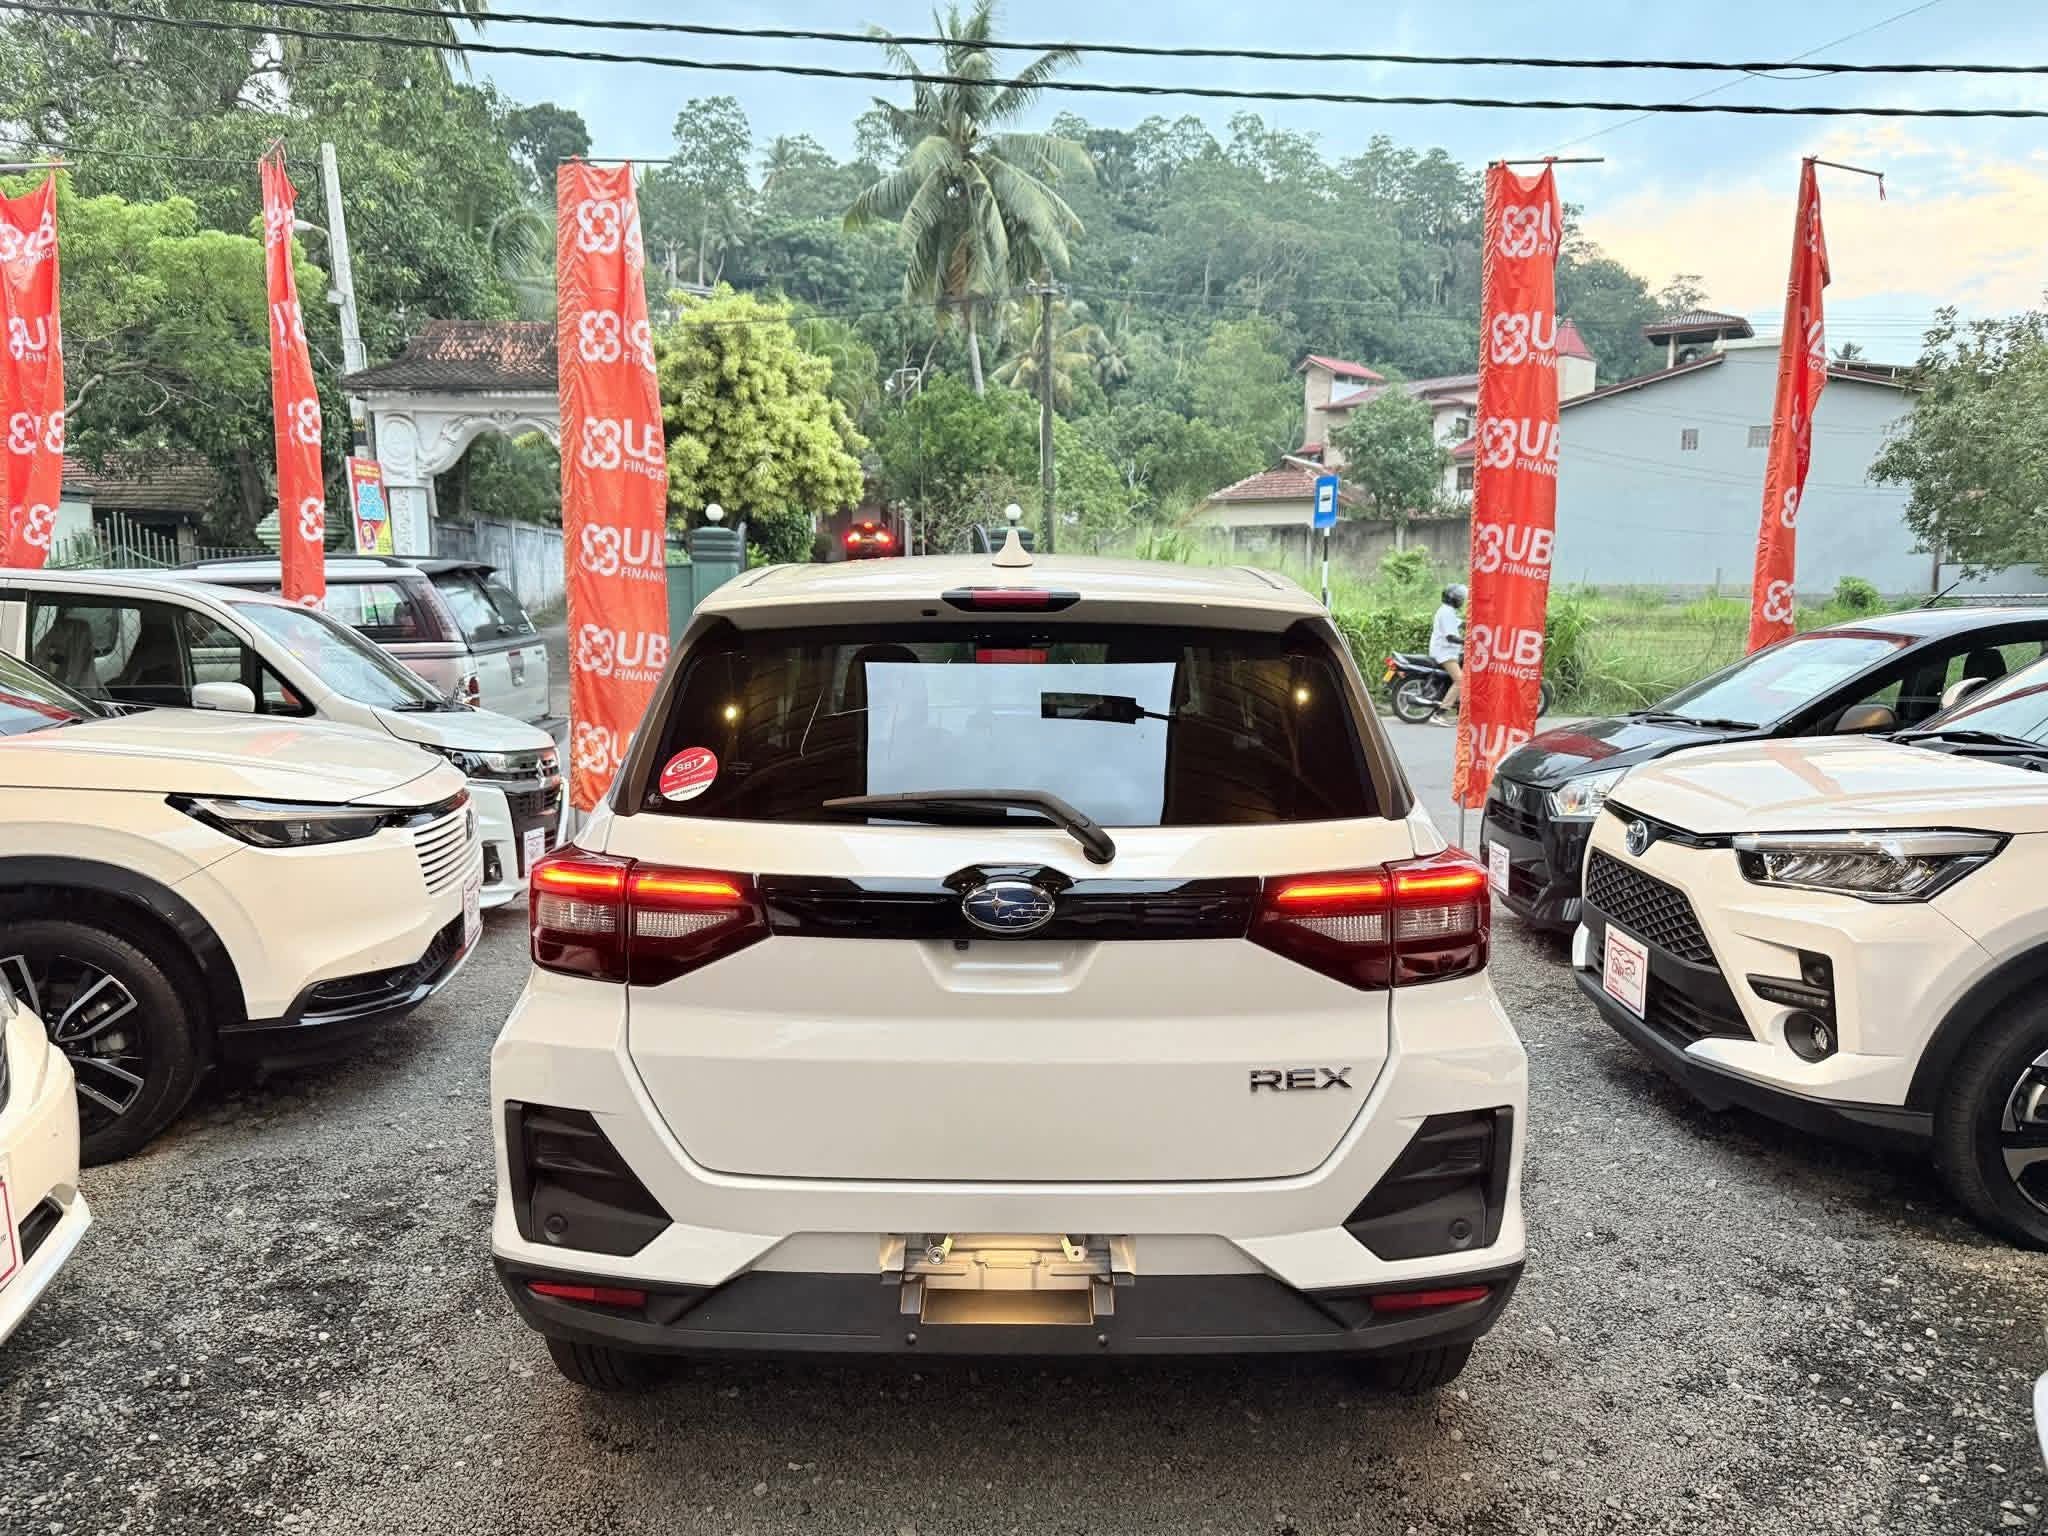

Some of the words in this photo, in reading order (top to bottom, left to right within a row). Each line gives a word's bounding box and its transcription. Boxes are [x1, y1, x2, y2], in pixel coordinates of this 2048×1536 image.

[1531, 311, 1557, 351] U
[1505, 523, 1553, 565] UB
[616, 631, 668, 668] UB
[1492, 625, 1543, 665] UB
[614, 668, 664, 681] FINANC
[676, 759, 700, 773] SBT
[1249, 1066, 1353, 1093] REX
